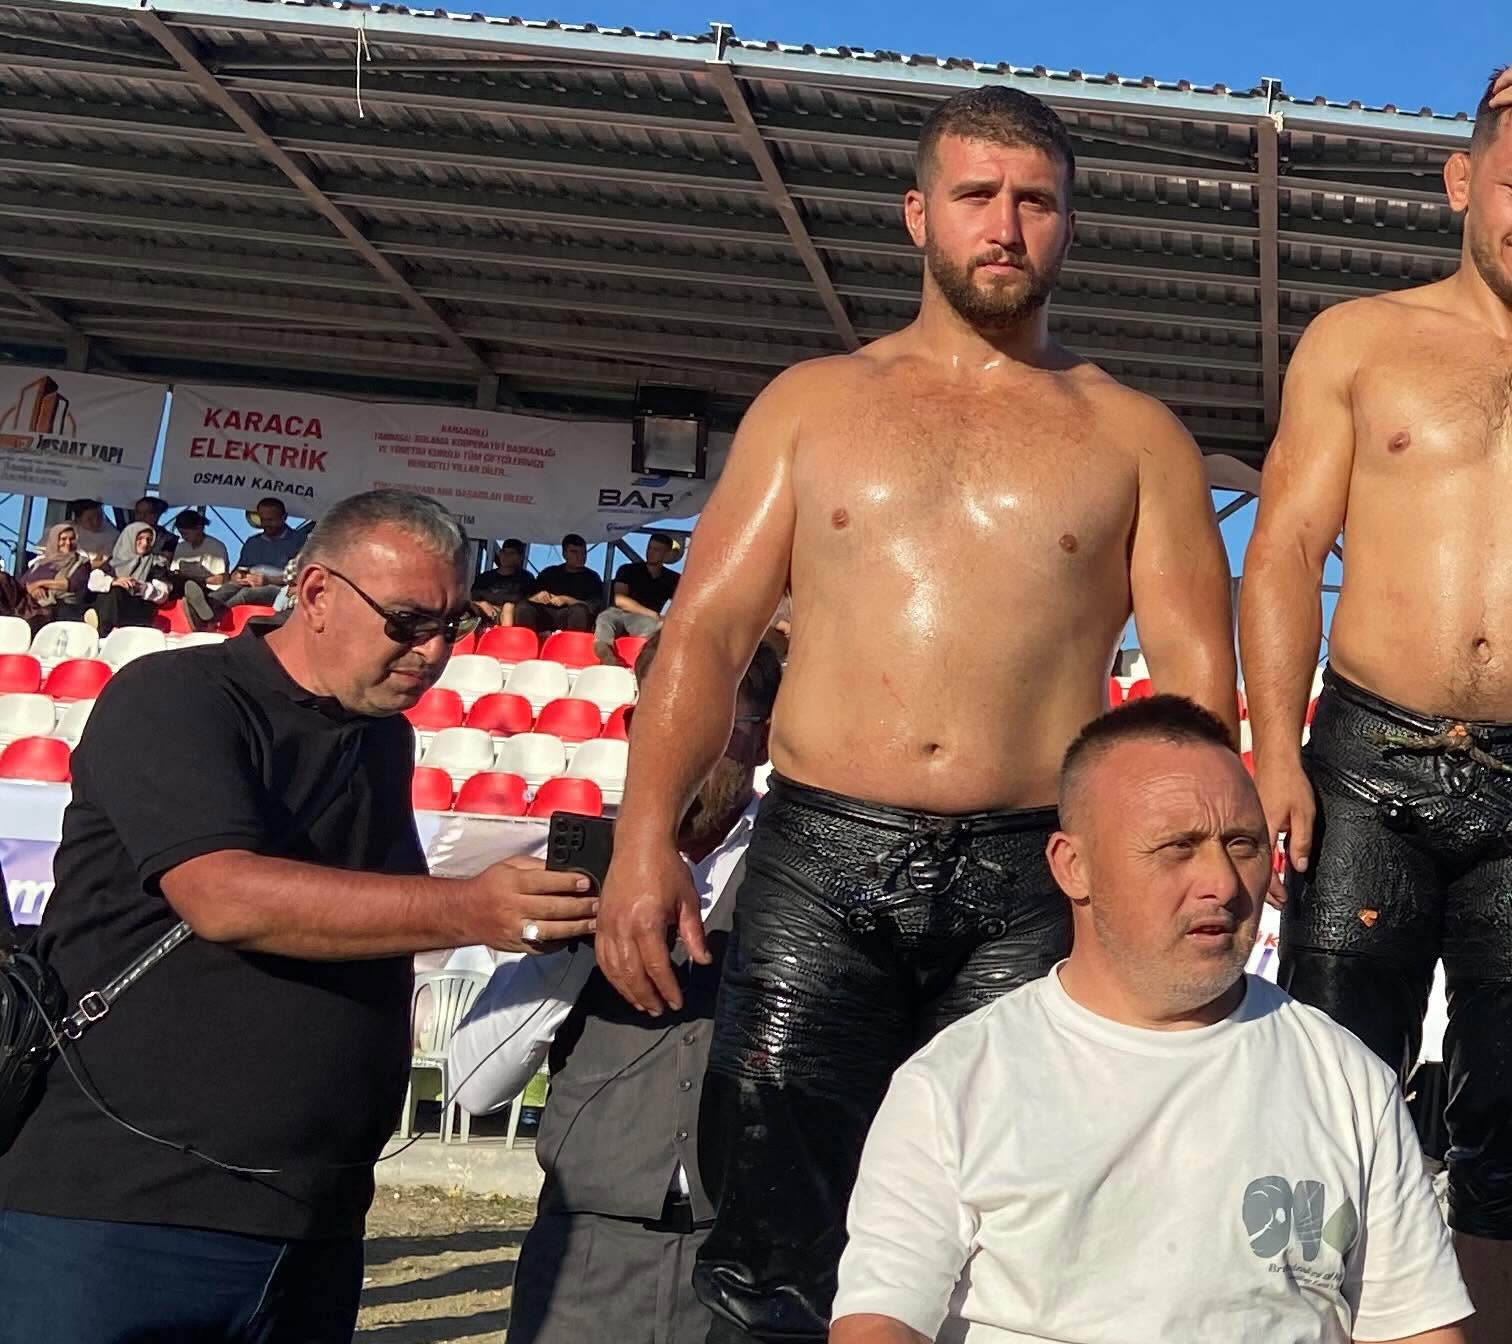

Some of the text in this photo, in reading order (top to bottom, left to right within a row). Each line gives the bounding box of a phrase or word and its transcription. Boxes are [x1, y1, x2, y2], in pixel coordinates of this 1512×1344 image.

[203, 407, 323, 439] KARACA
[190, 437, 328, 473] ELEKTRİK
[193, 472, 314, 498] OSMAN KARACA
